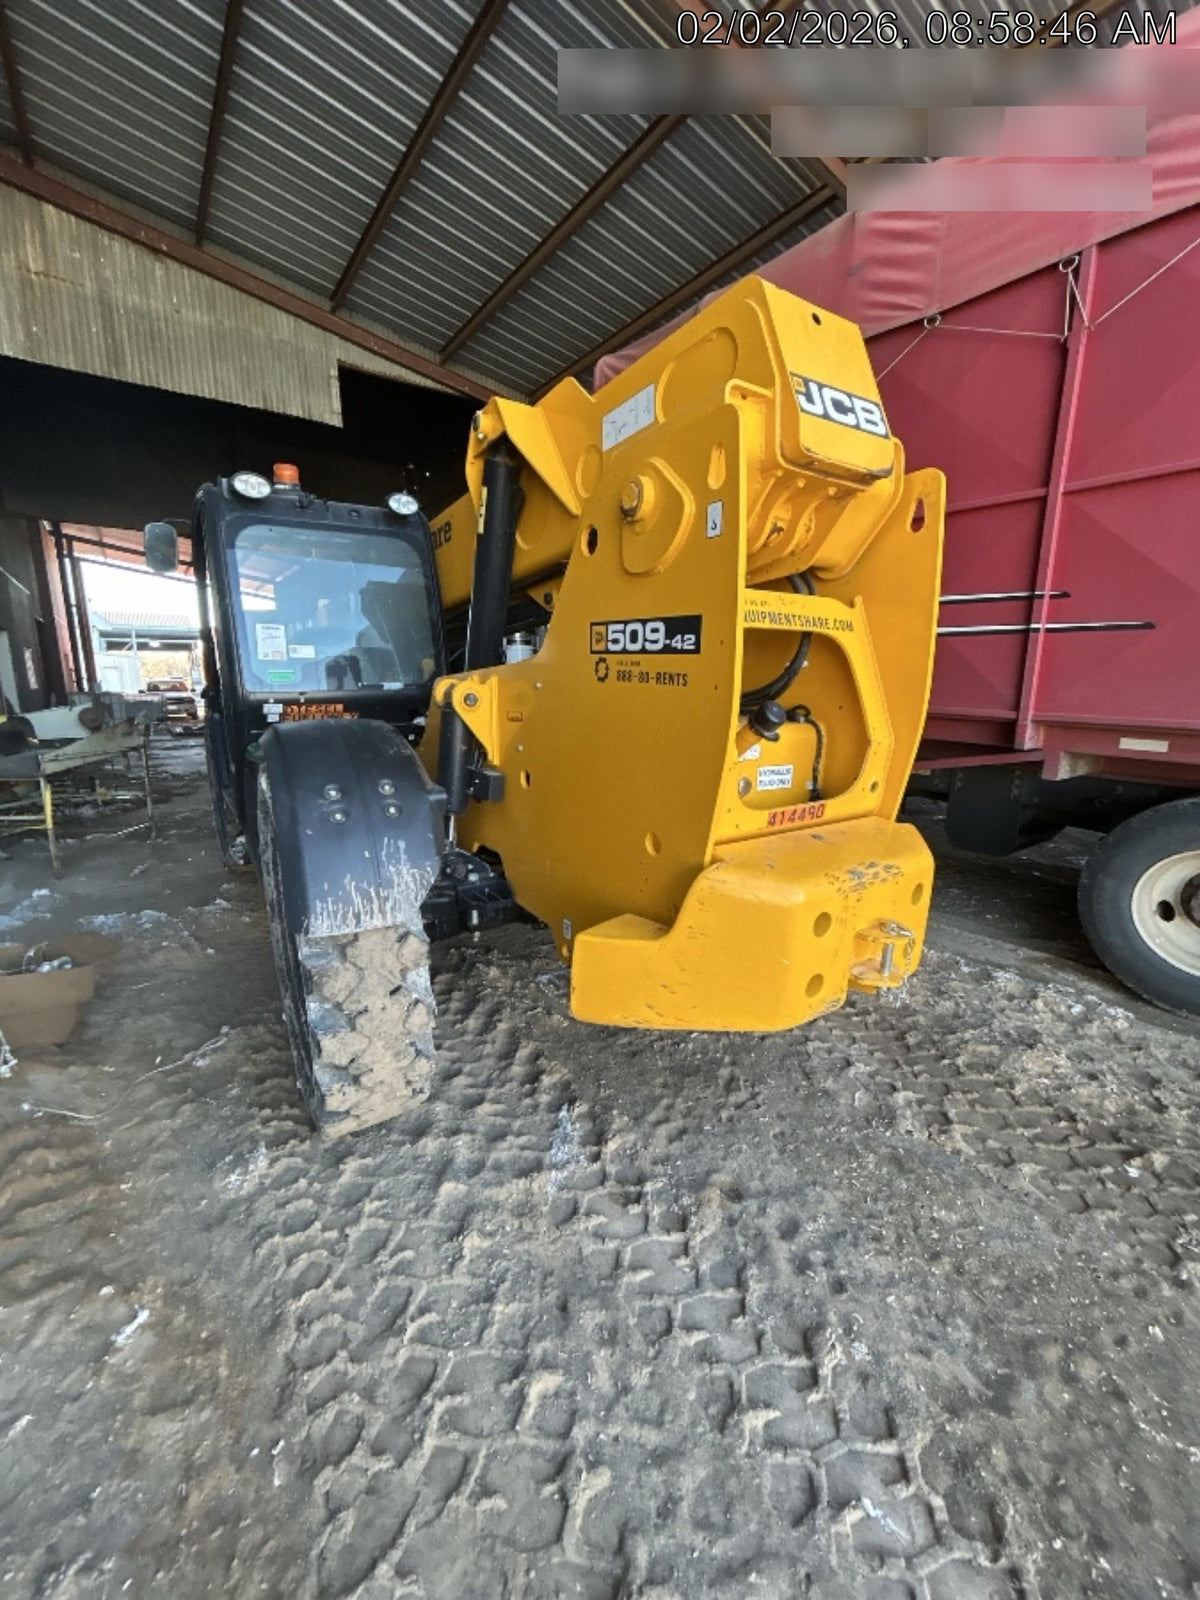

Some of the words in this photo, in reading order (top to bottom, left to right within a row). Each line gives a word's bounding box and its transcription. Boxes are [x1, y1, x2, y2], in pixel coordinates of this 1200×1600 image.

[797, 382, 886, 435] JCB
[607, 620, 696, 652] 509-42
[616, 669, 688, 688] 888-80-RENTS
[768, 803, 825, 827] 414490
